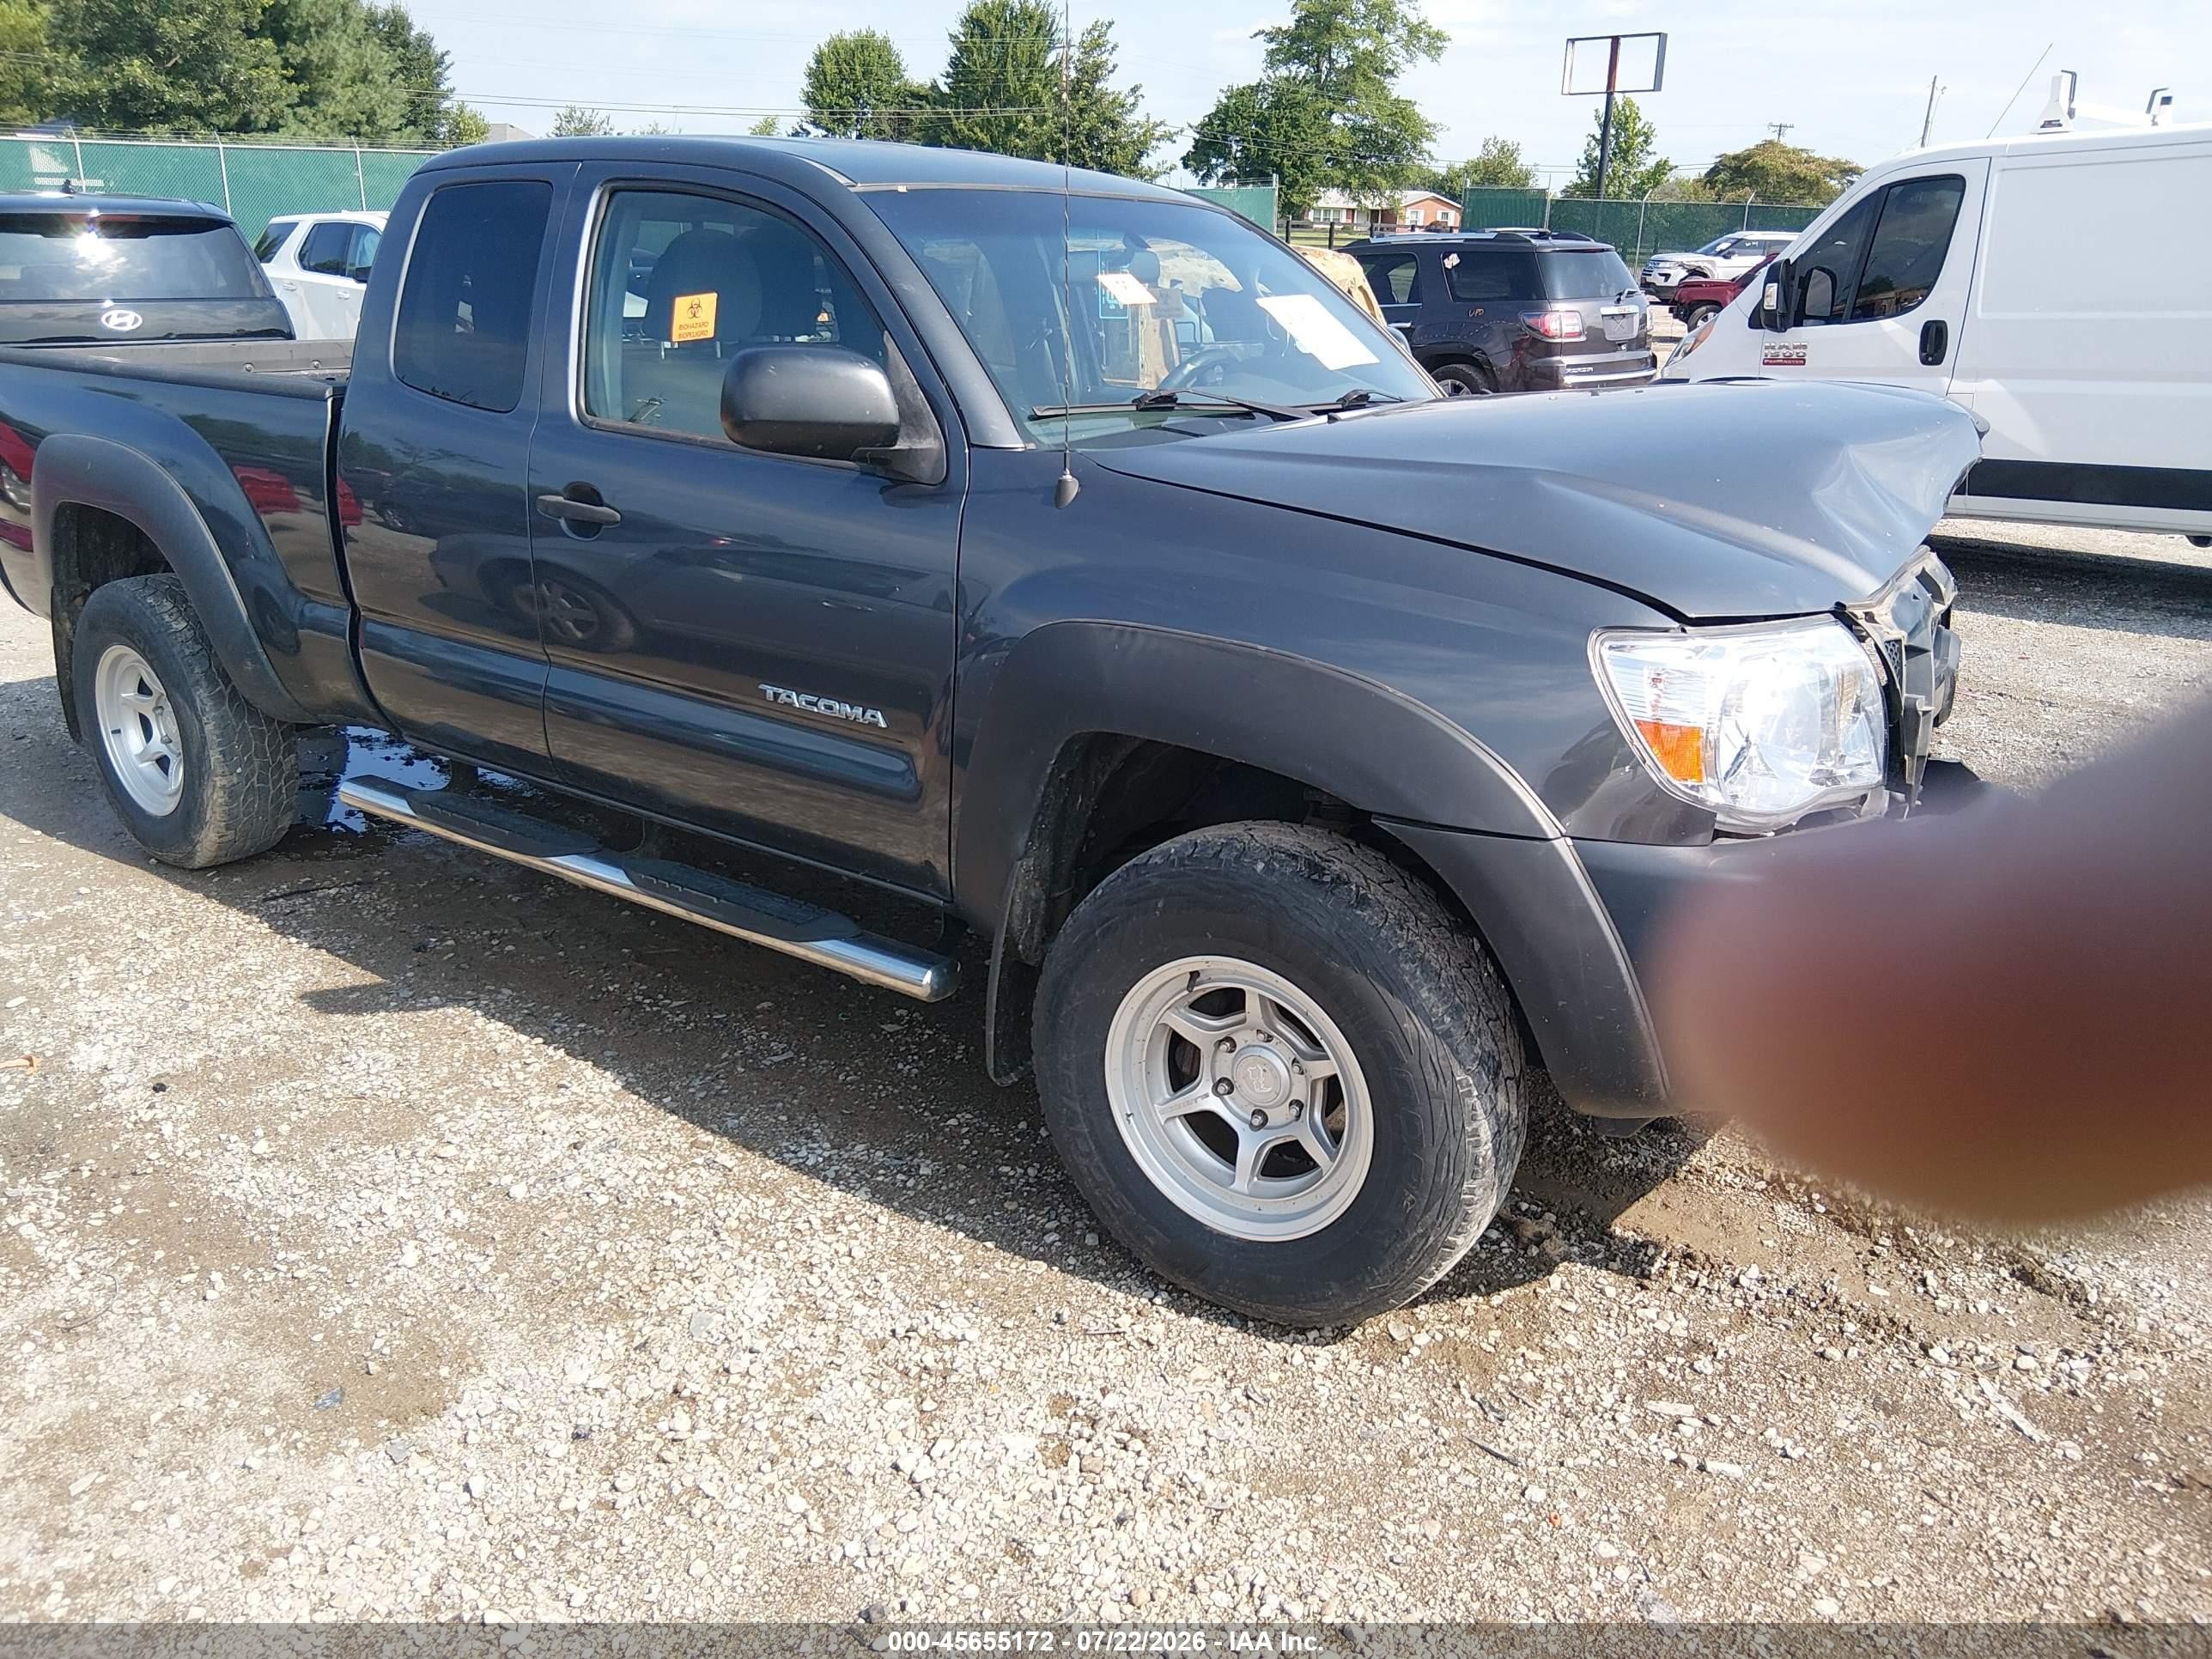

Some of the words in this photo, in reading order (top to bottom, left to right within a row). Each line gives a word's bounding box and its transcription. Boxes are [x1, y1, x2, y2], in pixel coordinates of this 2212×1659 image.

[679, 321, 709, 331] BIOHAZARD
[1765, 342, 1808, 350] RAM
[1765, 349, 1808, 358] 1500
[757, 682, 889, 728] TACOMA
